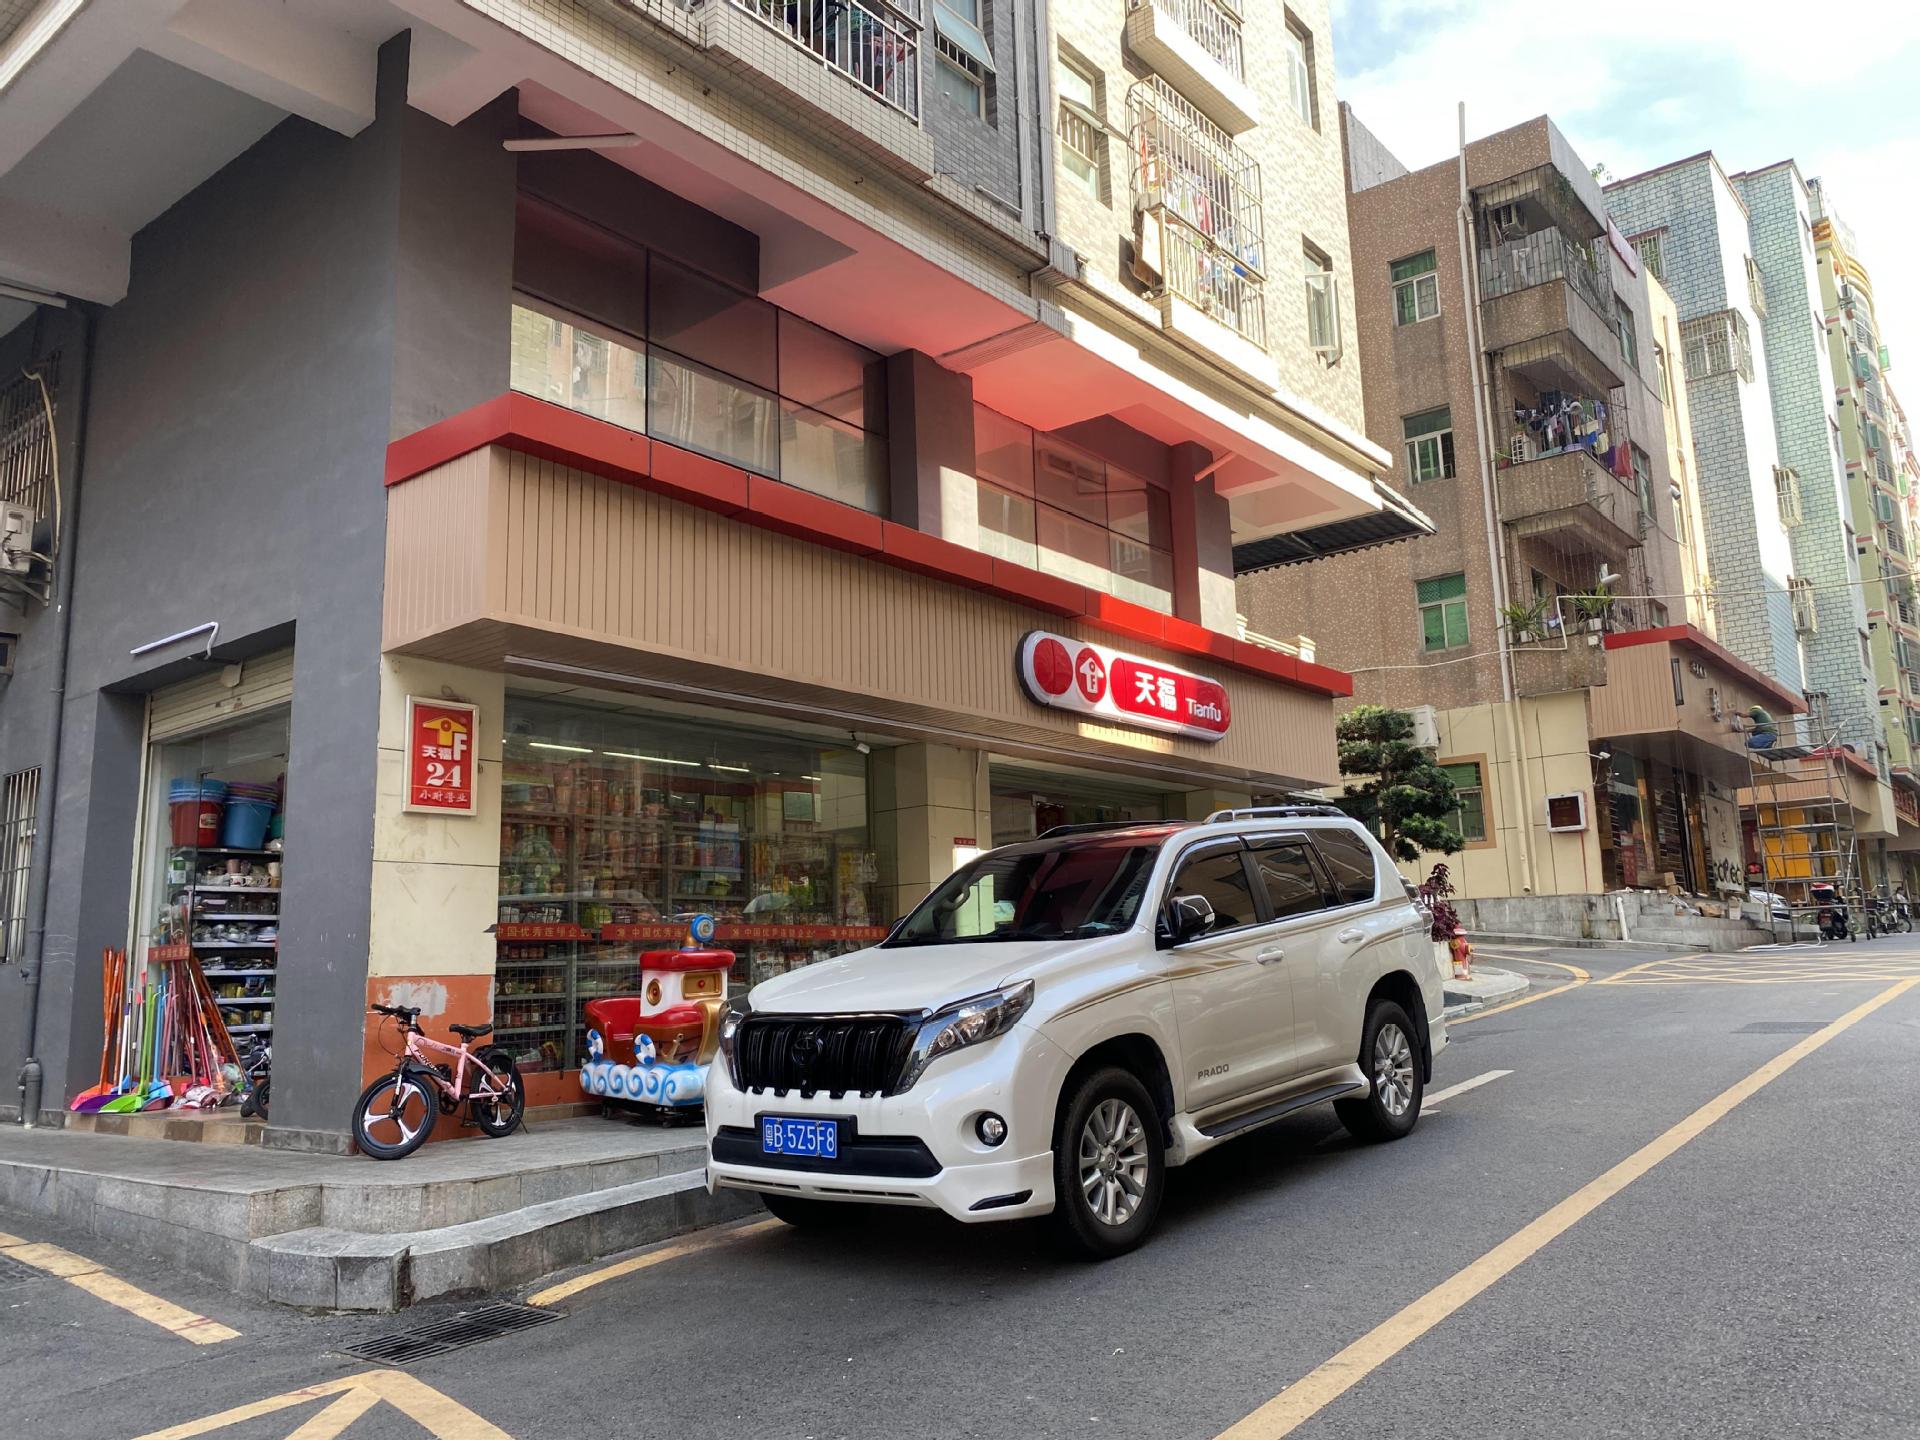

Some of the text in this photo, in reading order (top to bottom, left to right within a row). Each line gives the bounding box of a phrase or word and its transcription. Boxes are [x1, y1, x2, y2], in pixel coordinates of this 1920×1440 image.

[1135, 671, 1177, 711] 天福
[1185, 697, 1222, 722] Tianfu
[421, 744, 452, 761] 天福
[426, 762, 462, 788] 24
[1197, 1063, 1230, 1080] PRADO
